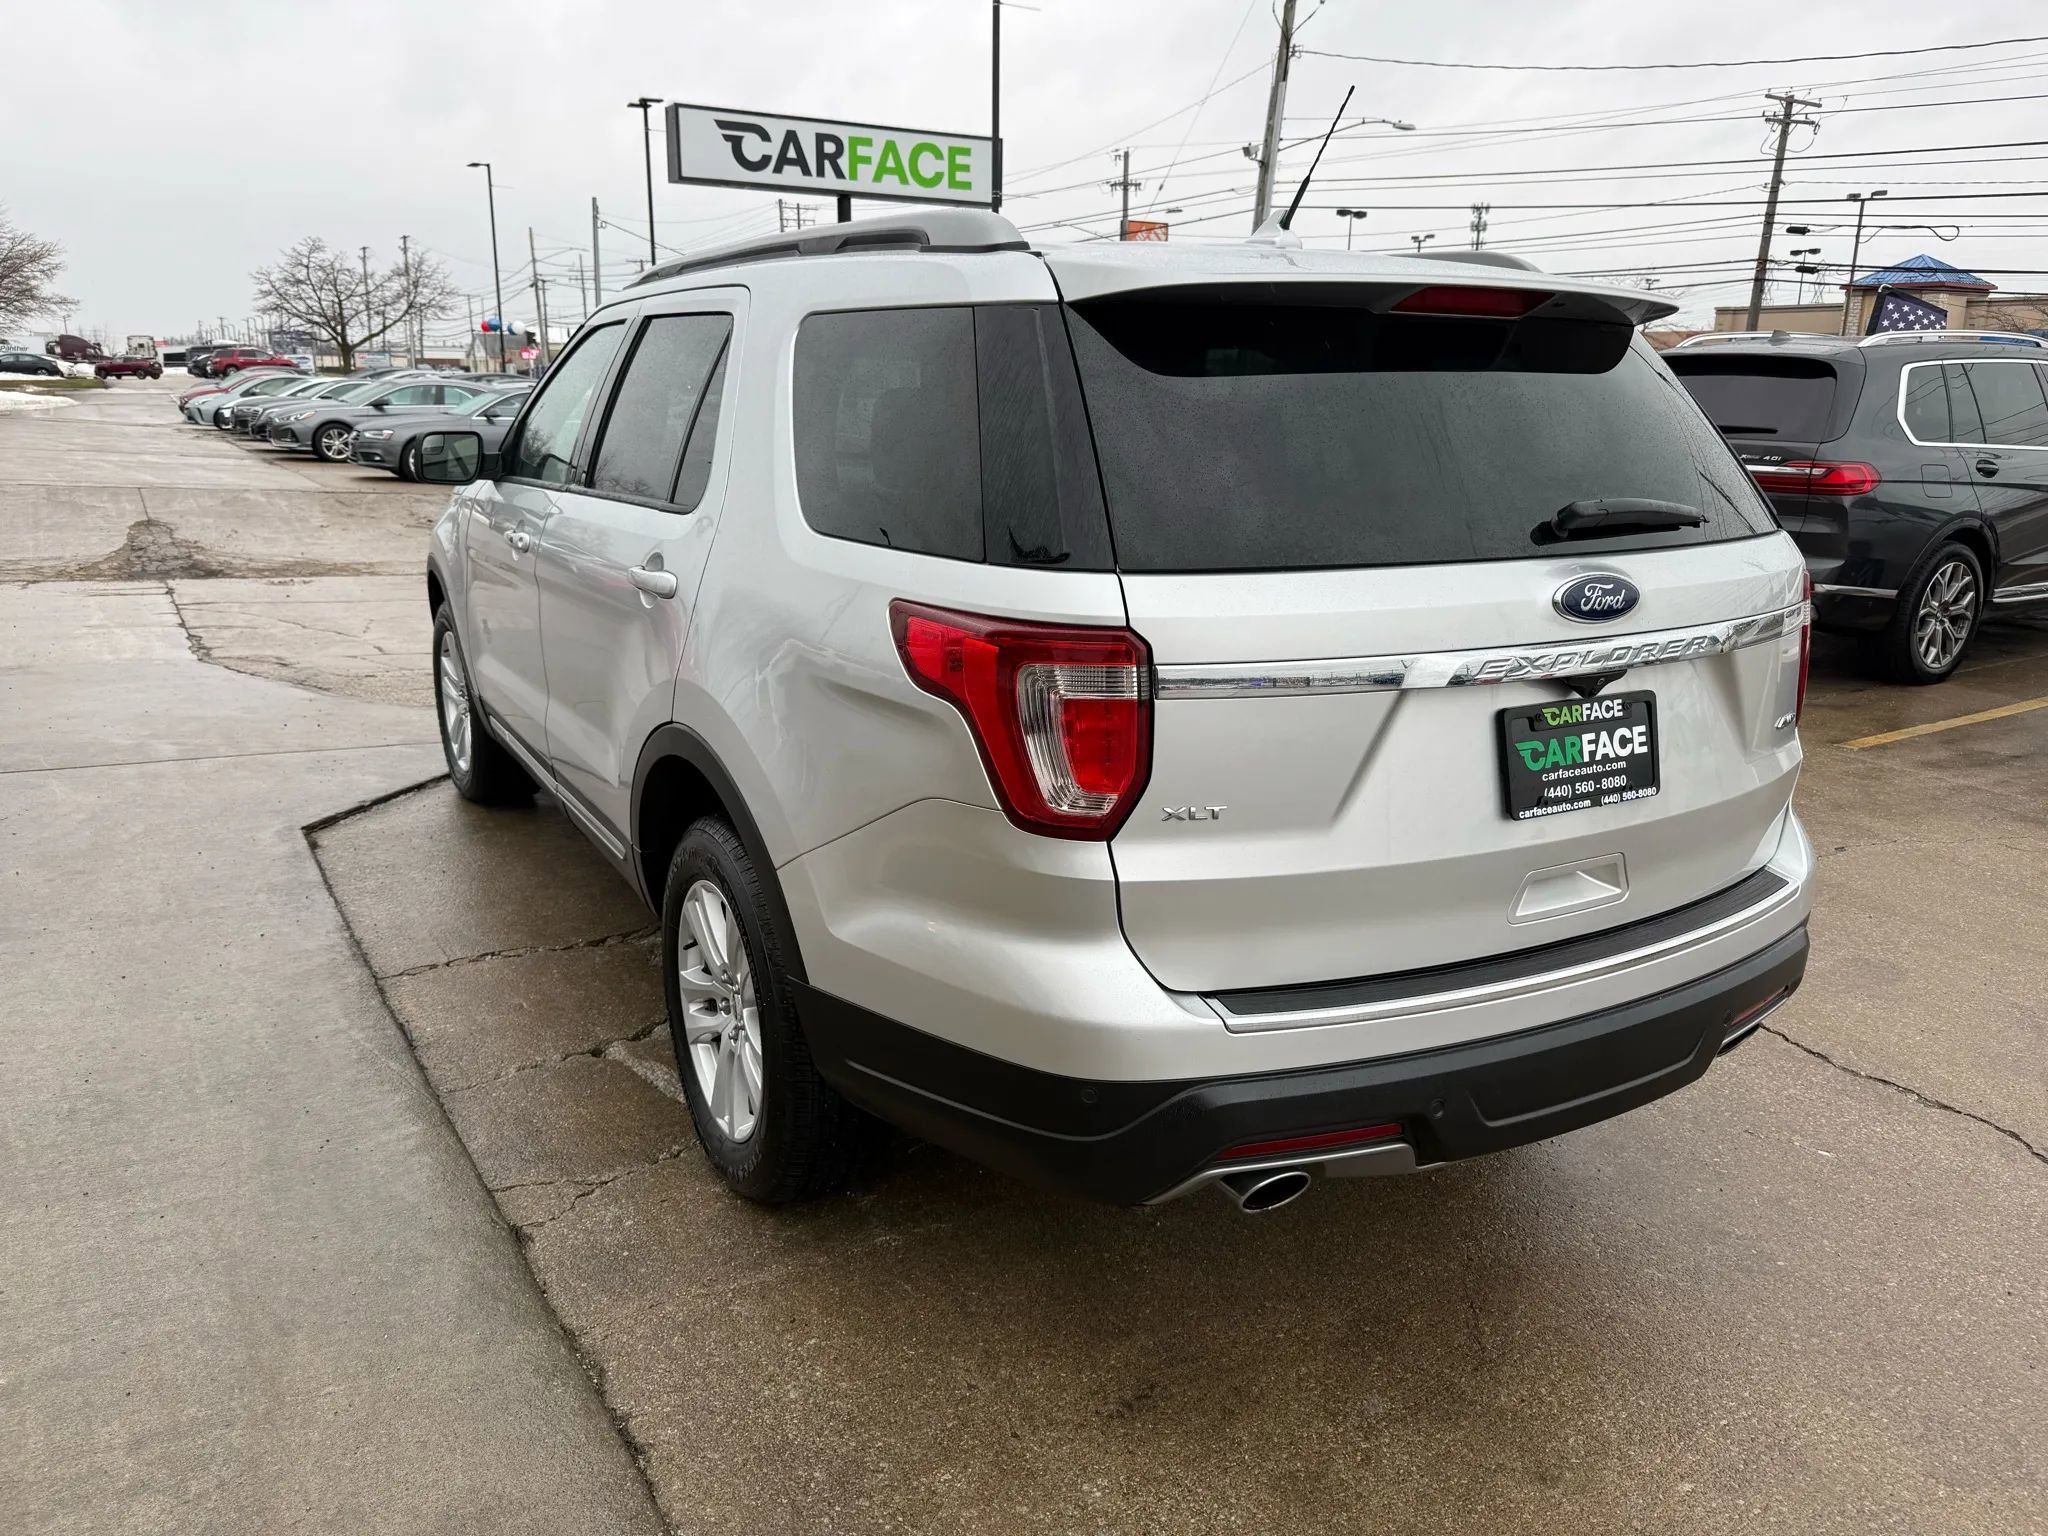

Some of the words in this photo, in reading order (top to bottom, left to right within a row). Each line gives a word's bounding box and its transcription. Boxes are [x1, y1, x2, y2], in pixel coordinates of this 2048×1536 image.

[714, 118, 972, 191] CARFACE
[1581, 583, 1625, 611] Ford
[1475, 636, 1708, 680] EXPLORER
[1542, 699, 1623, 726] CARFACE
[1515, 725, 1648, 771] CARFACE
[1542, 760, 1627, 782] carfaceauto.com
[1544, 784, 1572, 799] (440)
[1601, 794, 1621, 806] (440)
[1622, 786, 1657, 801] 560-8080
[1161, 805, 1228, 821] XLT
[1519, 799, 1591, 819] carfaceauto.com
